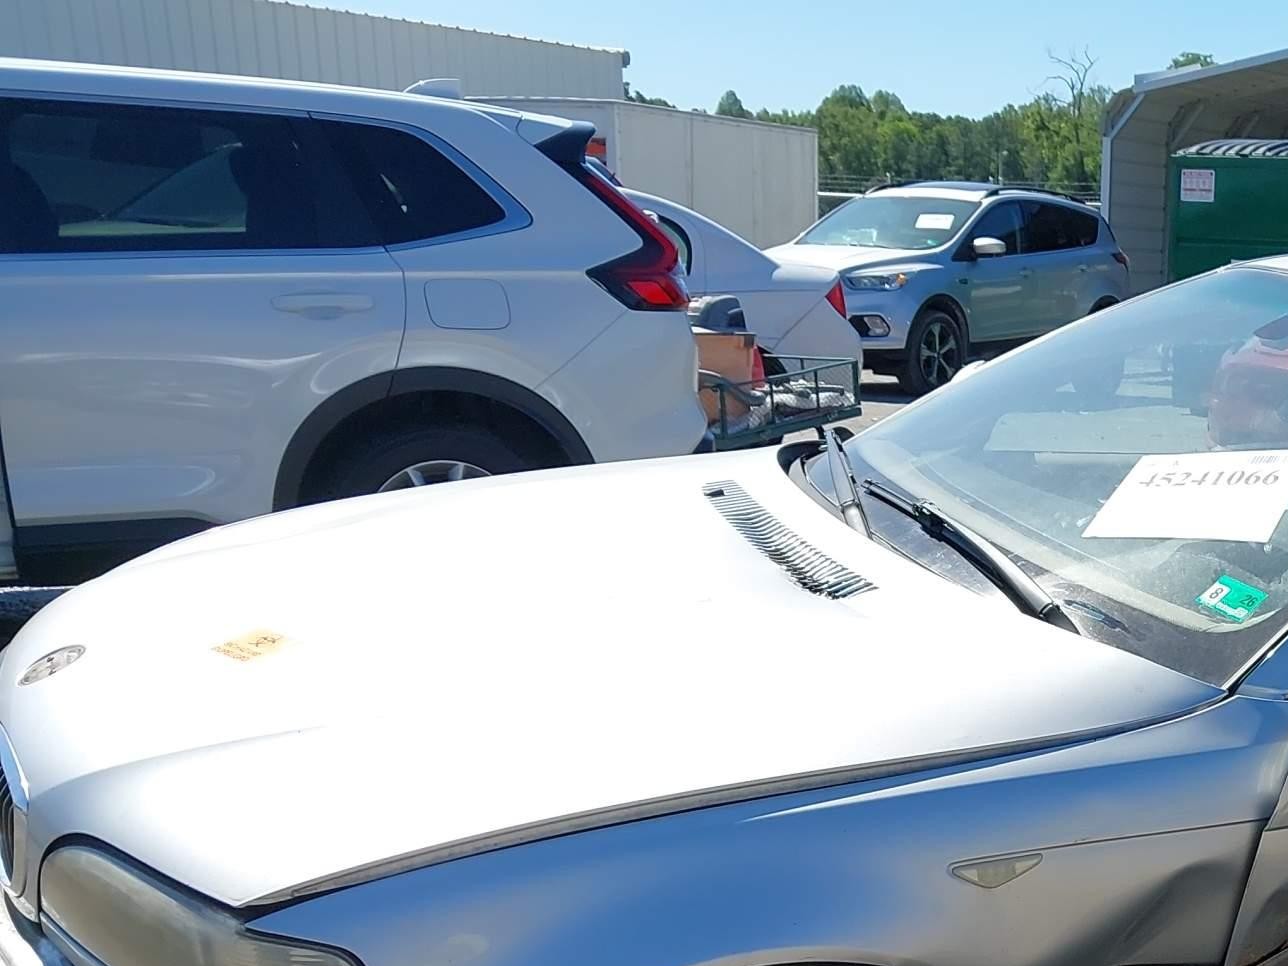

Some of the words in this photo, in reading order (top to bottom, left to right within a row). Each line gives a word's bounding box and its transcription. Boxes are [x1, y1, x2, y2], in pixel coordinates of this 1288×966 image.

[1138, 469, 1281, 488] 45241066
[1209, 587, 1224, 600] 8
[1239, 594, 1258, 608] 26
